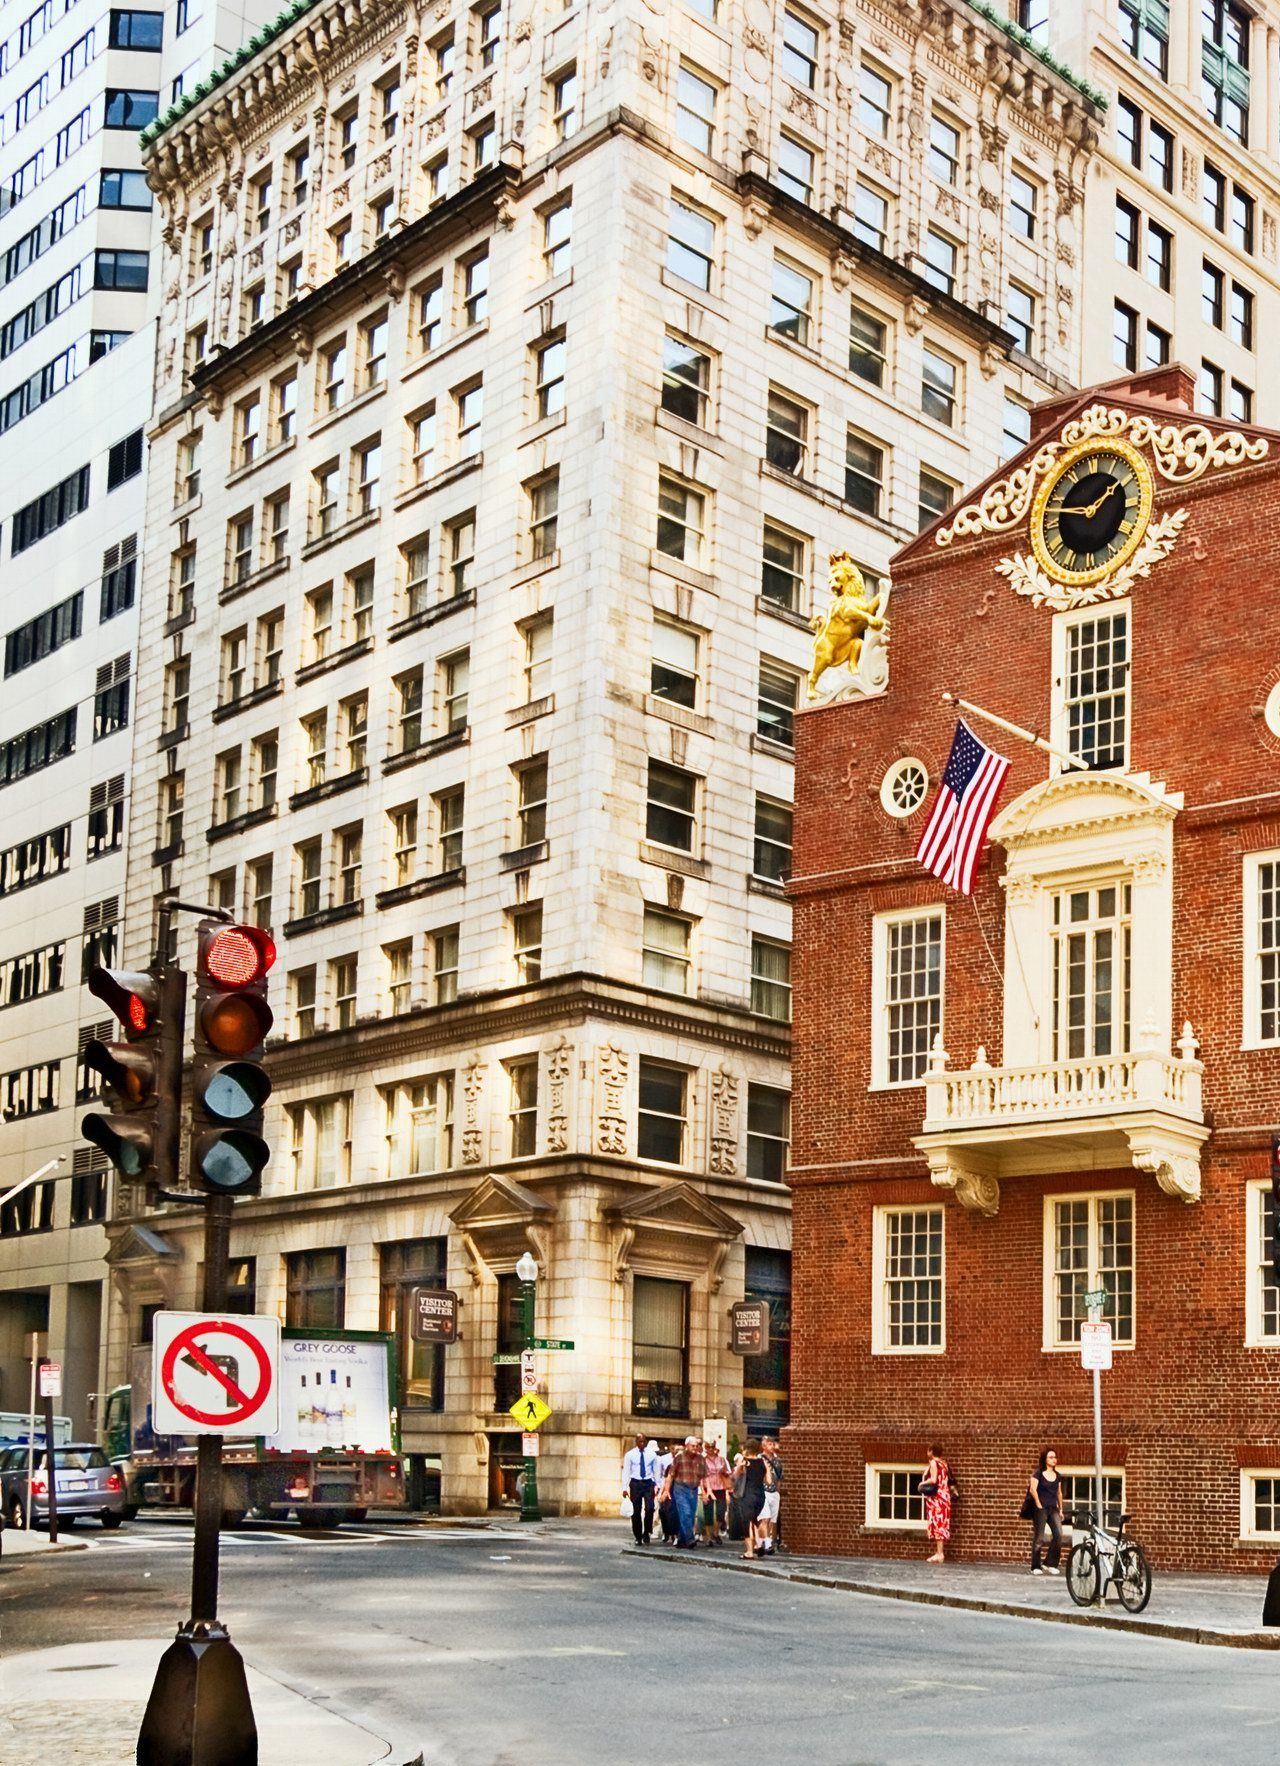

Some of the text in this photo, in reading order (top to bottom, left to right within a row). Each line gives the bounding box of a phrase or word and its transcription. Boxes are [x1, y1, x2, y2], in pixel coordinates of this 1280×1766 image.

[420, 1297, 453, 1308] VISITOR
[420, 1306, 453, 1316] CENTER
[735, 1311, 760, 1319] VISITOR
[735, 1319, 760, 1327] CENTER
[293, 1343, 357, 1355] GREY GOOSE
[546, 1341, 561, 1349] STATE
